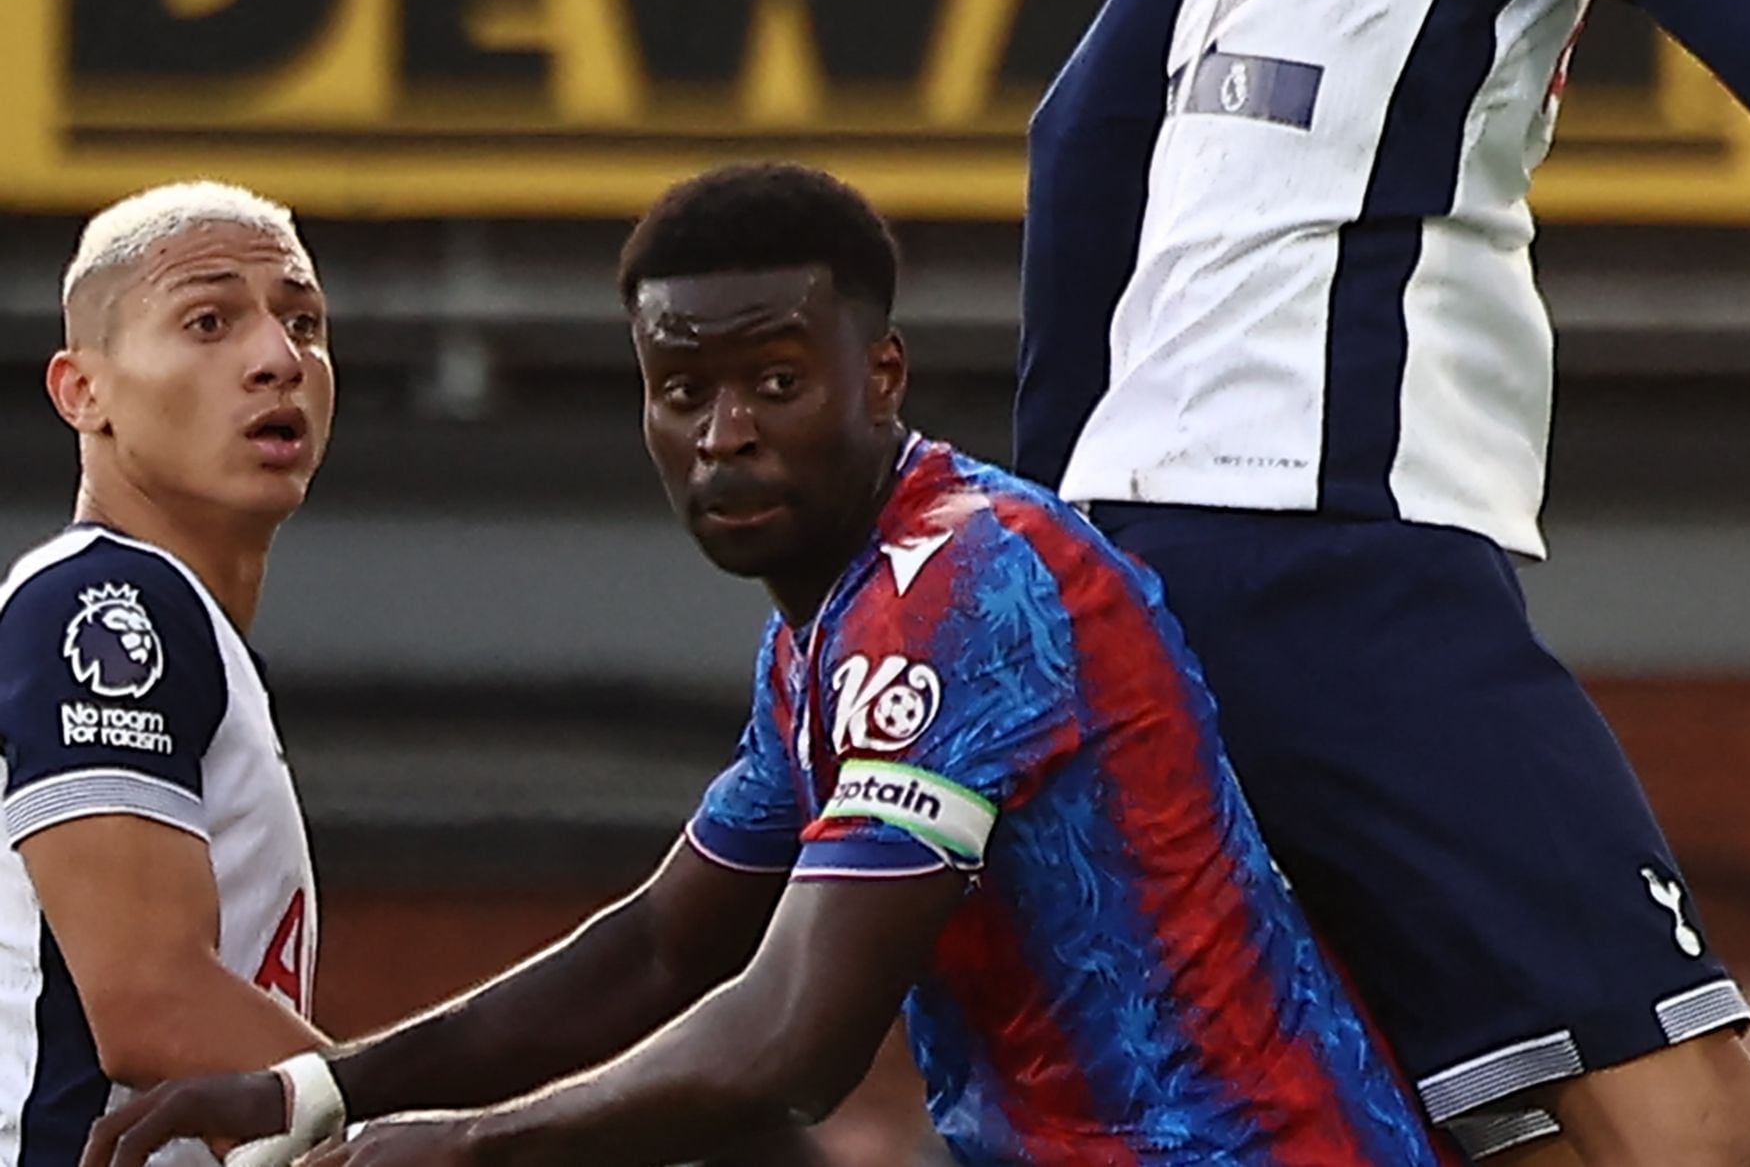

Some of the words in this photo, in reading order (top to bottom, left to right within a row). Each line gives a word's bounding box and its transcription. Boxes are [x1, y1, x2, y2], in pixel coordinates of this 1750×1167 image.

[61, 702, 99, 726] No
[101, 708, 164, 732] room
[101, 727, 173, 755] racism
